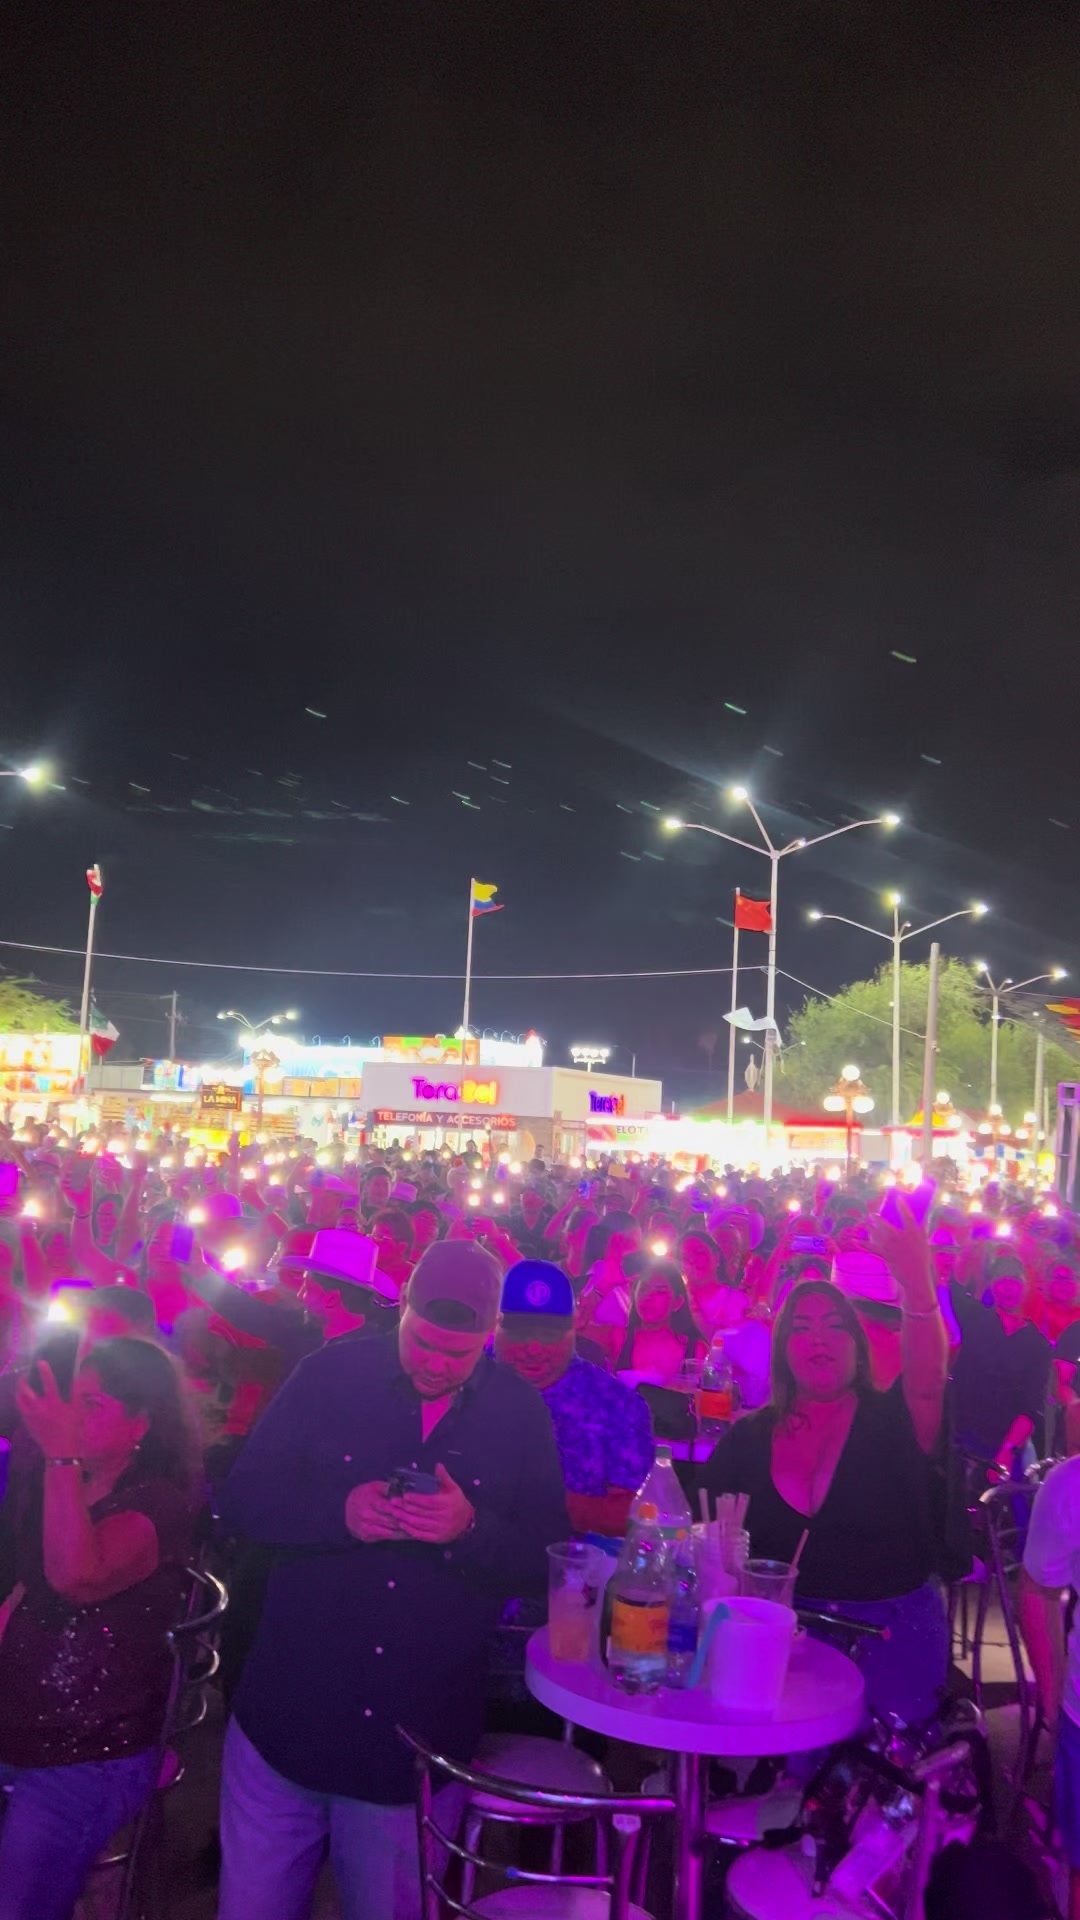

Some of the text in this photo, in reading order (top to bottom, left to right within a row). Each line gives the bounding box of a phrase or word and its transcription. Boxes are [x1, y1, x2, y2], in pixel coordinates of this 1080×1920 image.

[203, 1095, 215, 1103] LA
[436, 1114, 444, 1123] Y
[447, 1115, 516, 1127] ACCESORIOS
